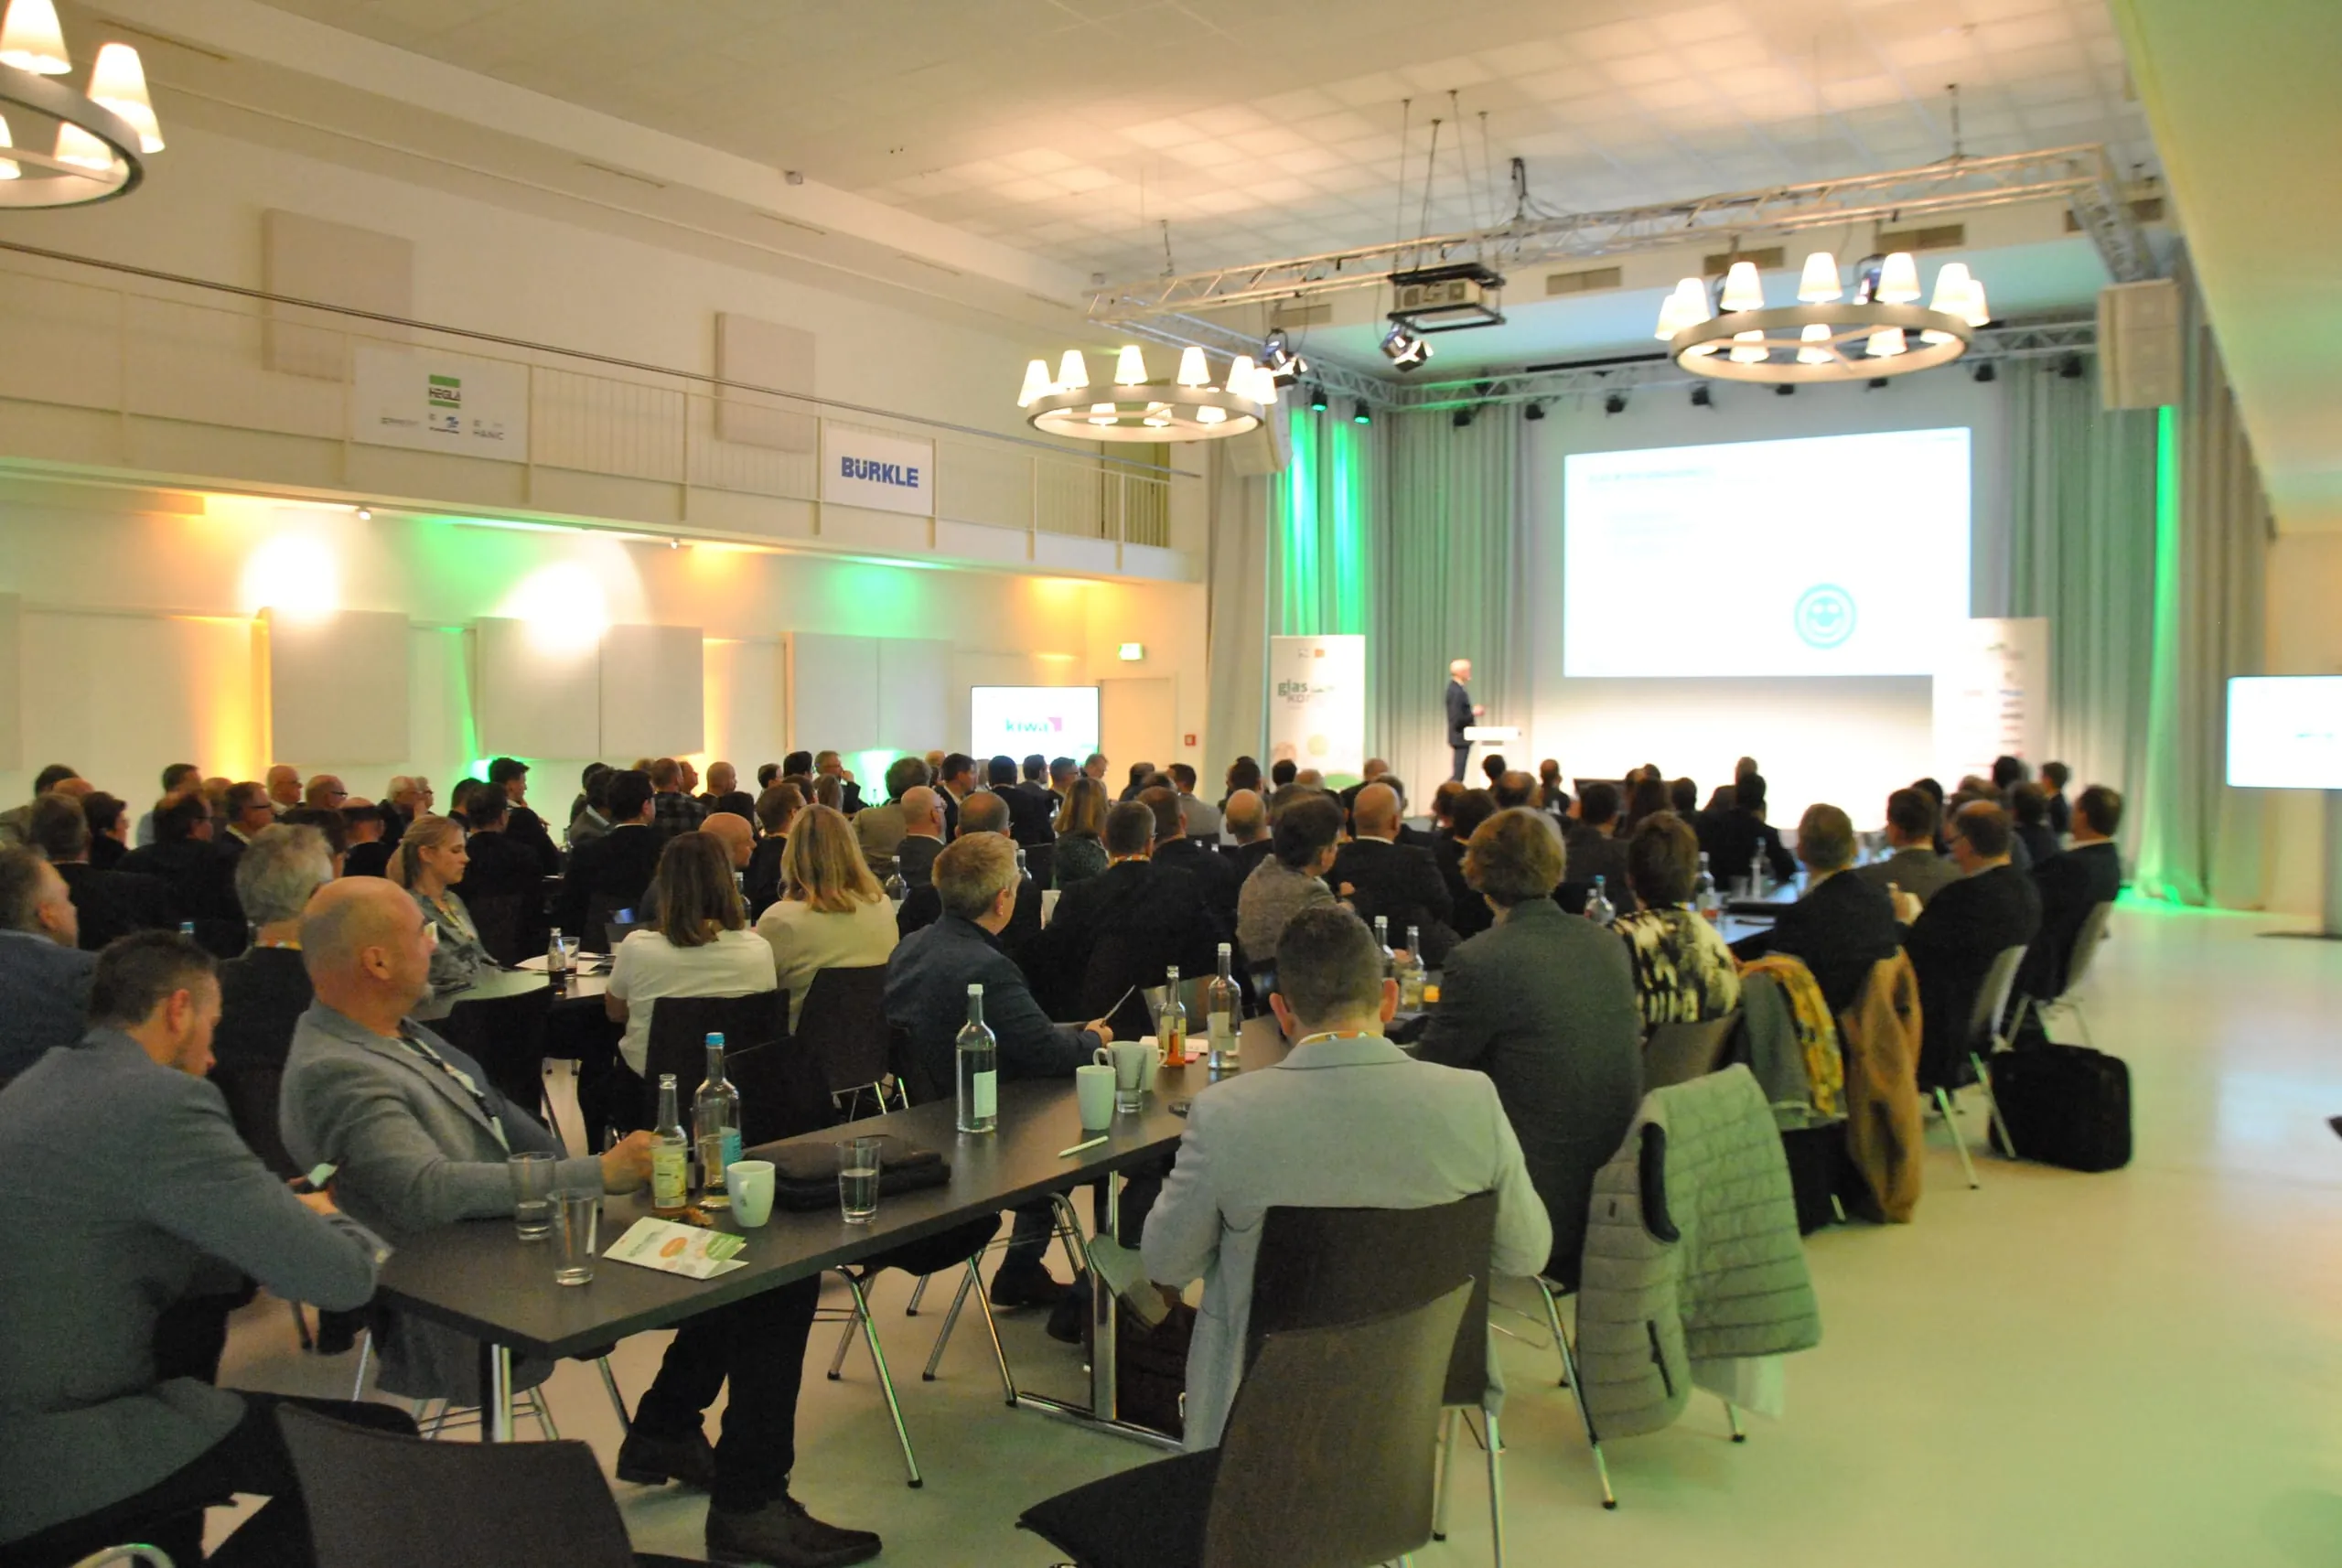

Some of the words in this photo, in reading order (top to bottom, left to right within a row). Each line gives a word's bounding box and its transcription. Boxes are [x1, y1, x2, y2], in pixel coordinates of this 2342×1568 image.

[429, 388, 461, 402] HEGLA
[842, 456, 919, 488] BÜRKLE
[1278, 679, 1307, 696] glas
